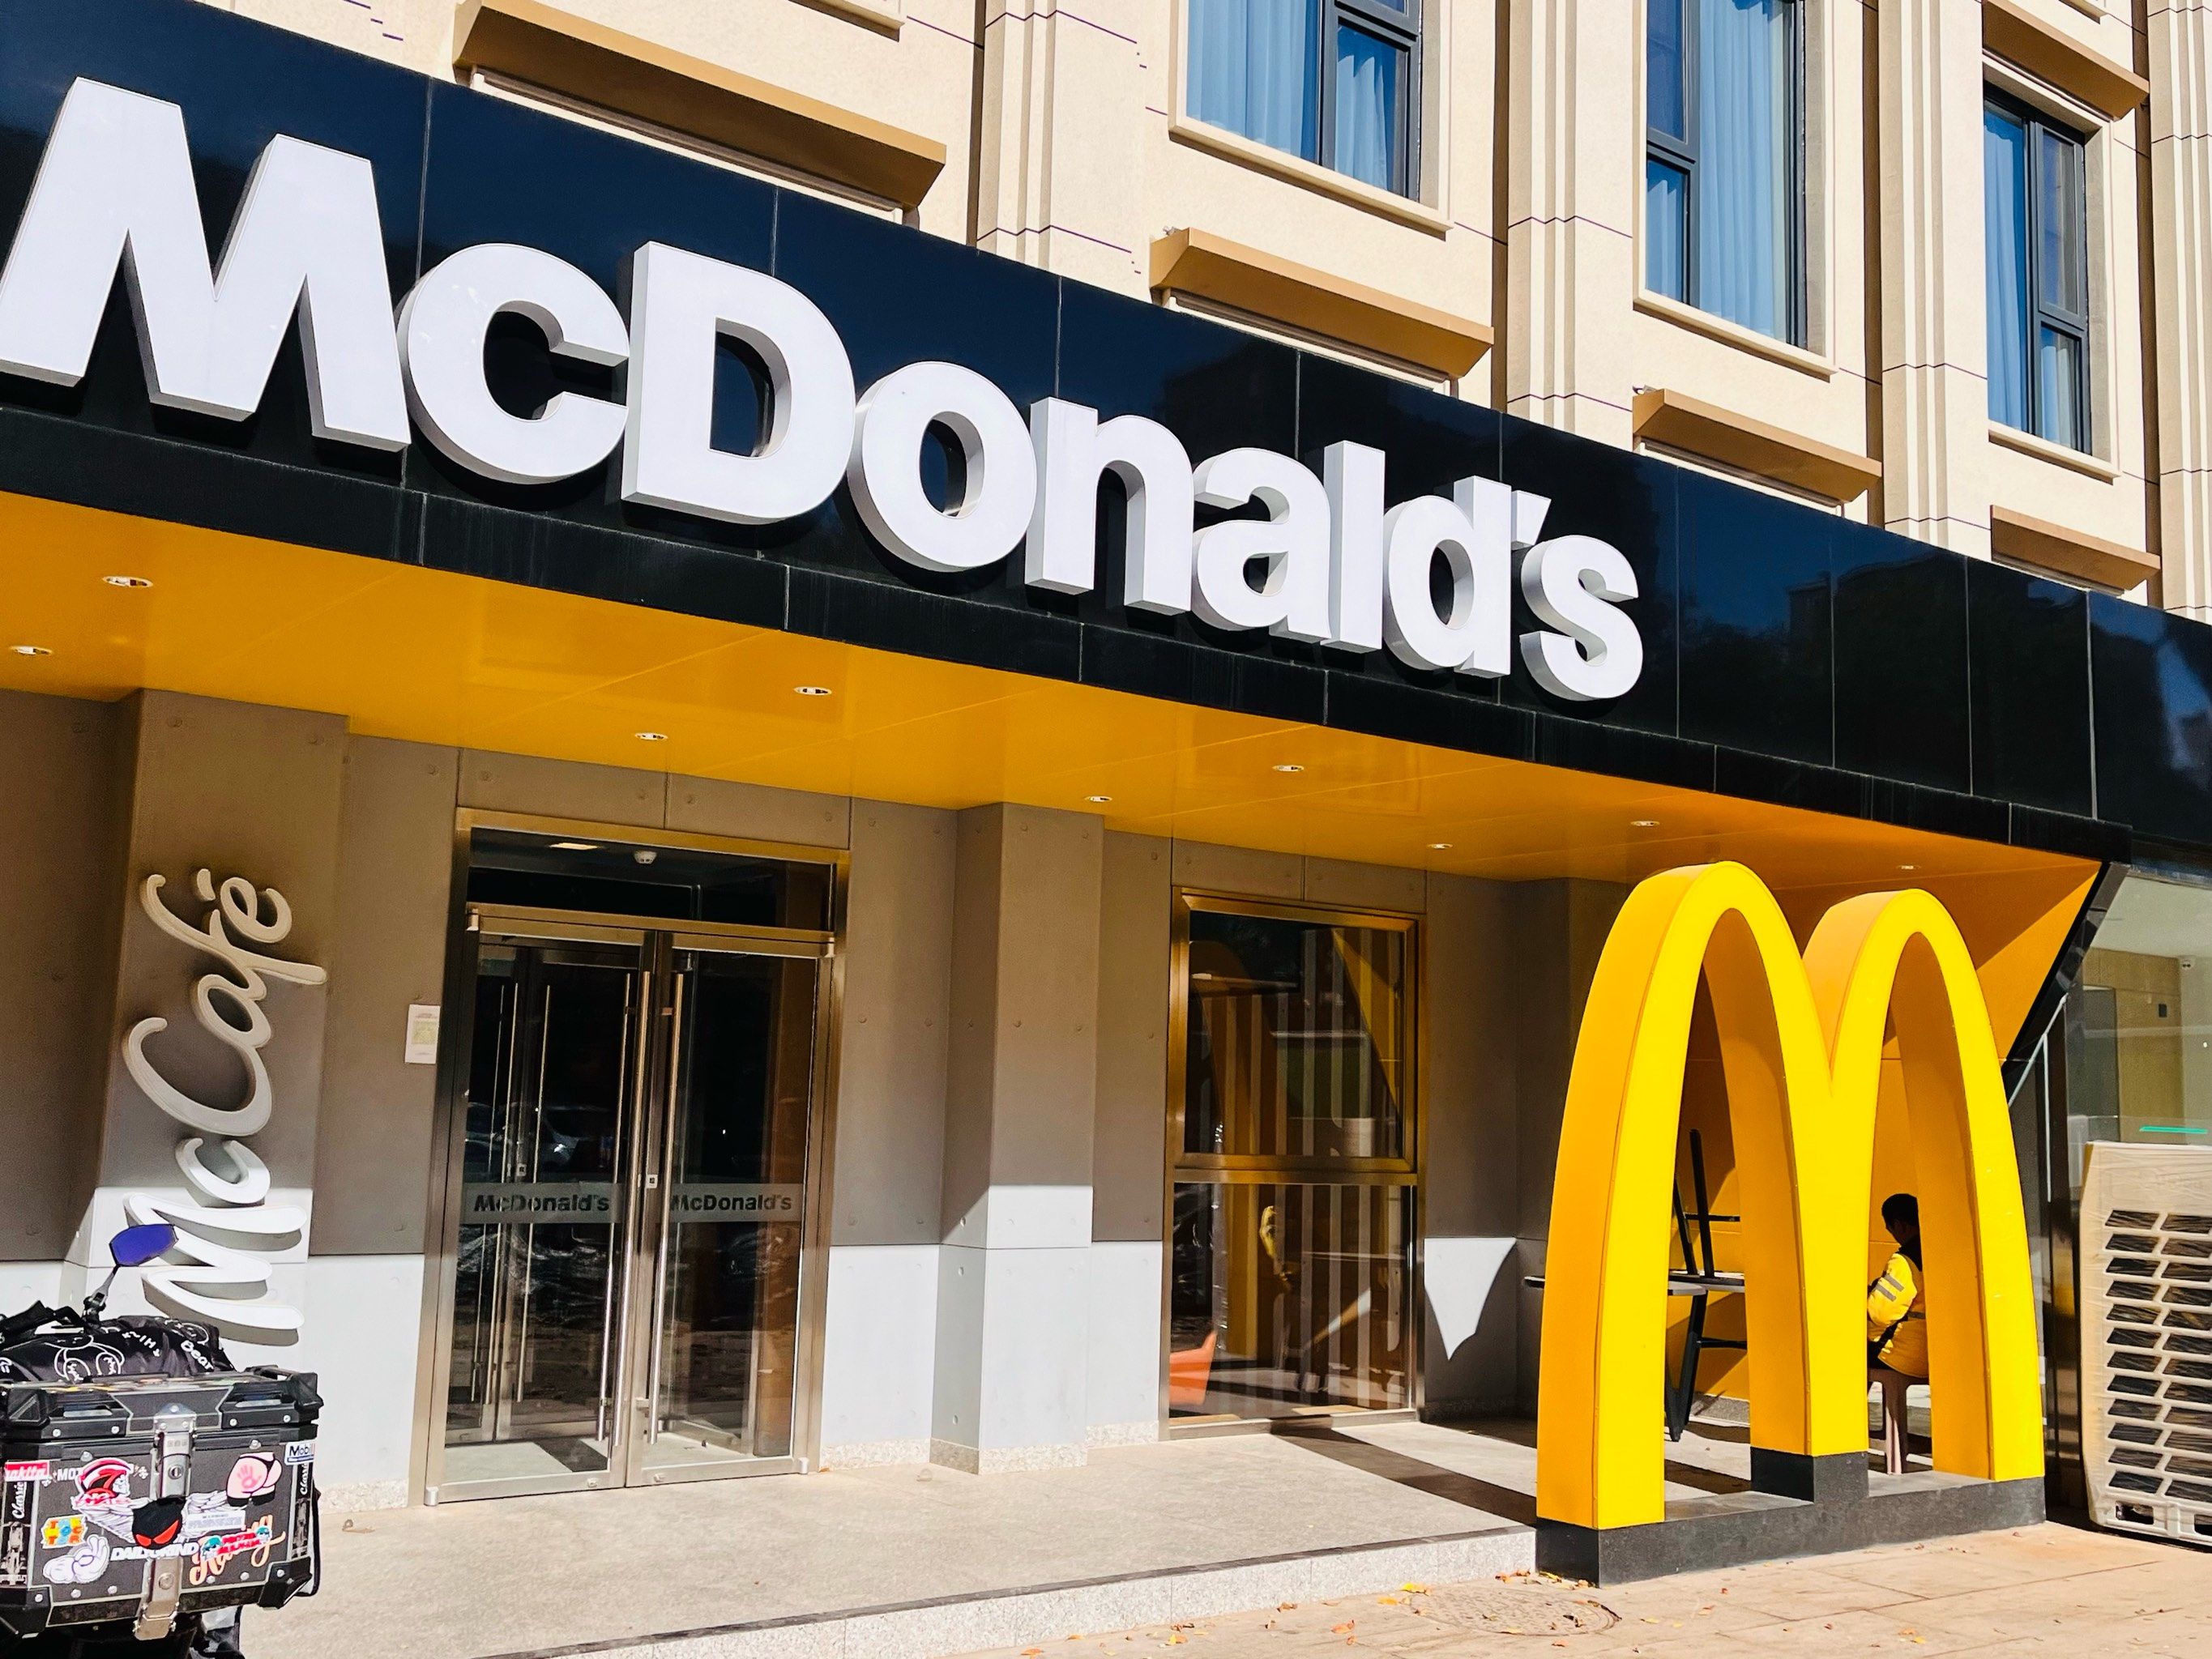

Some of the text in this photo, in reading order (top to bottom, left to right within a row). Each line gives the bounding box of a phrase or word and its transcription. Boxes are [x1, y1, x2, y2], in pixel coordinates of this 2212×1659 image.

[0, 77, 1645, 704] McDonald's
[123, 868, 327, 1338] McCafé
[473, 1194, 610, 1212] McDonald's
[671, 1194, 792, 1211] McDonald's
[180, 1340, 215, 1371] Bear
